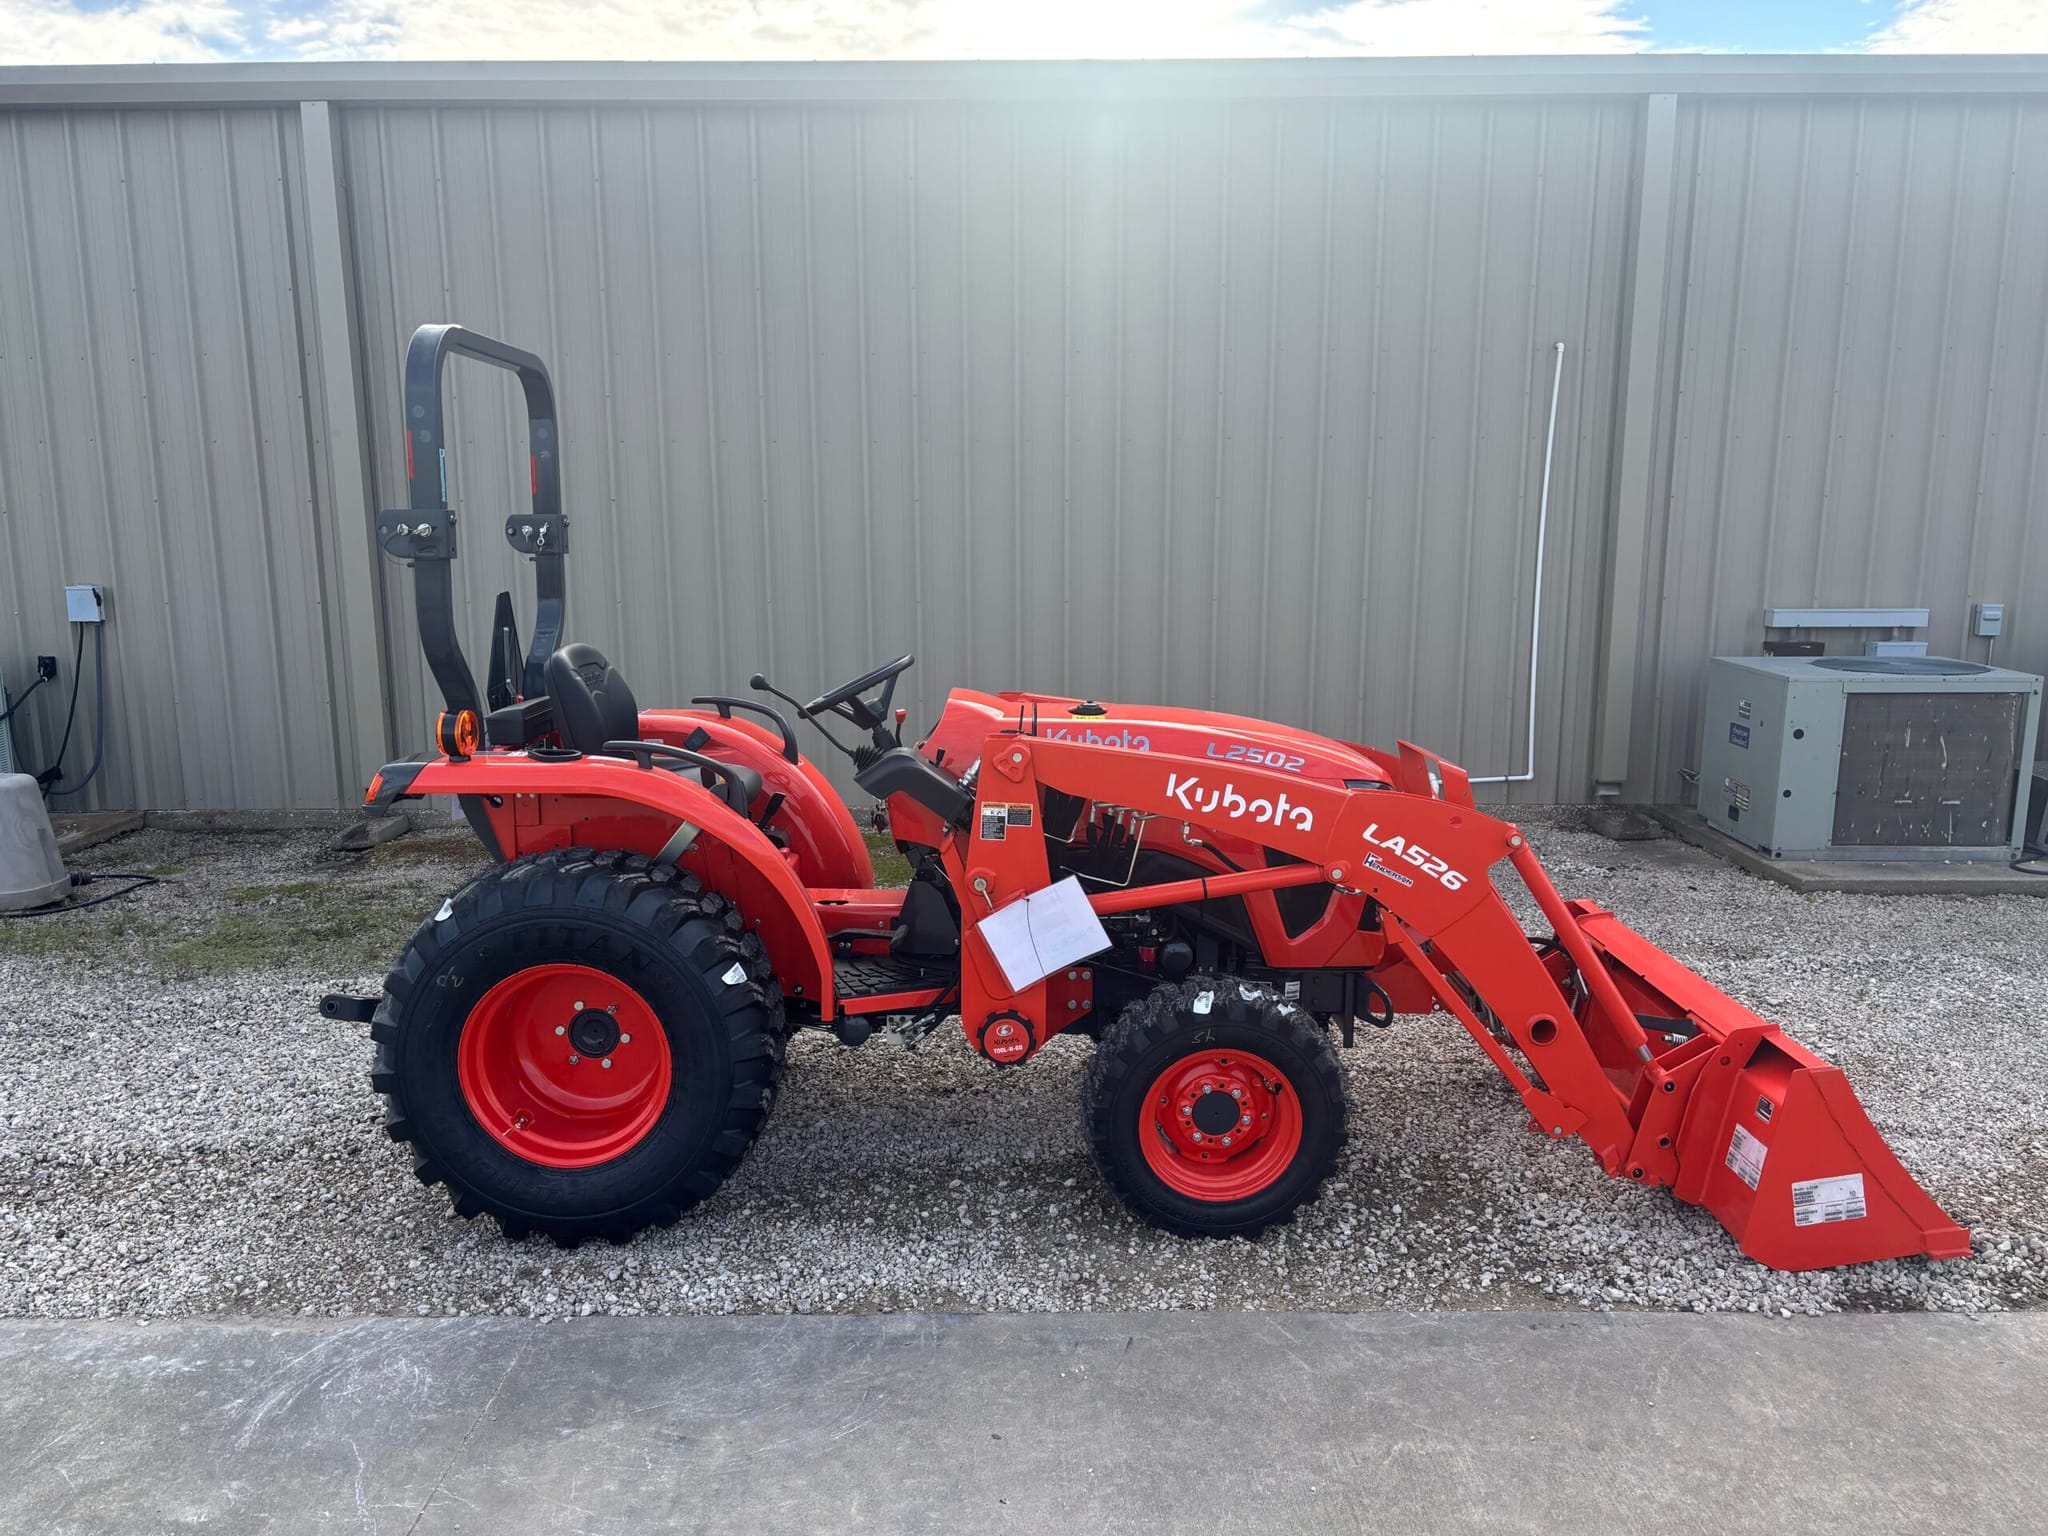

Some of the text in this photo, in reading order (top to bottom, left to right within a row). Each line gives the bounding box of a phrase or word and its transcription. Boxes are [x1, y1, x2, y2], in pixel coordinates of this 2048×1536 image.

[1206, 742, 1305, 773] L2502
[1166, 773, 1313, 832] Kubota
[1362, 822, 1468, 890] LA526
[1363, 852, 1413, 886] HENDERSON
